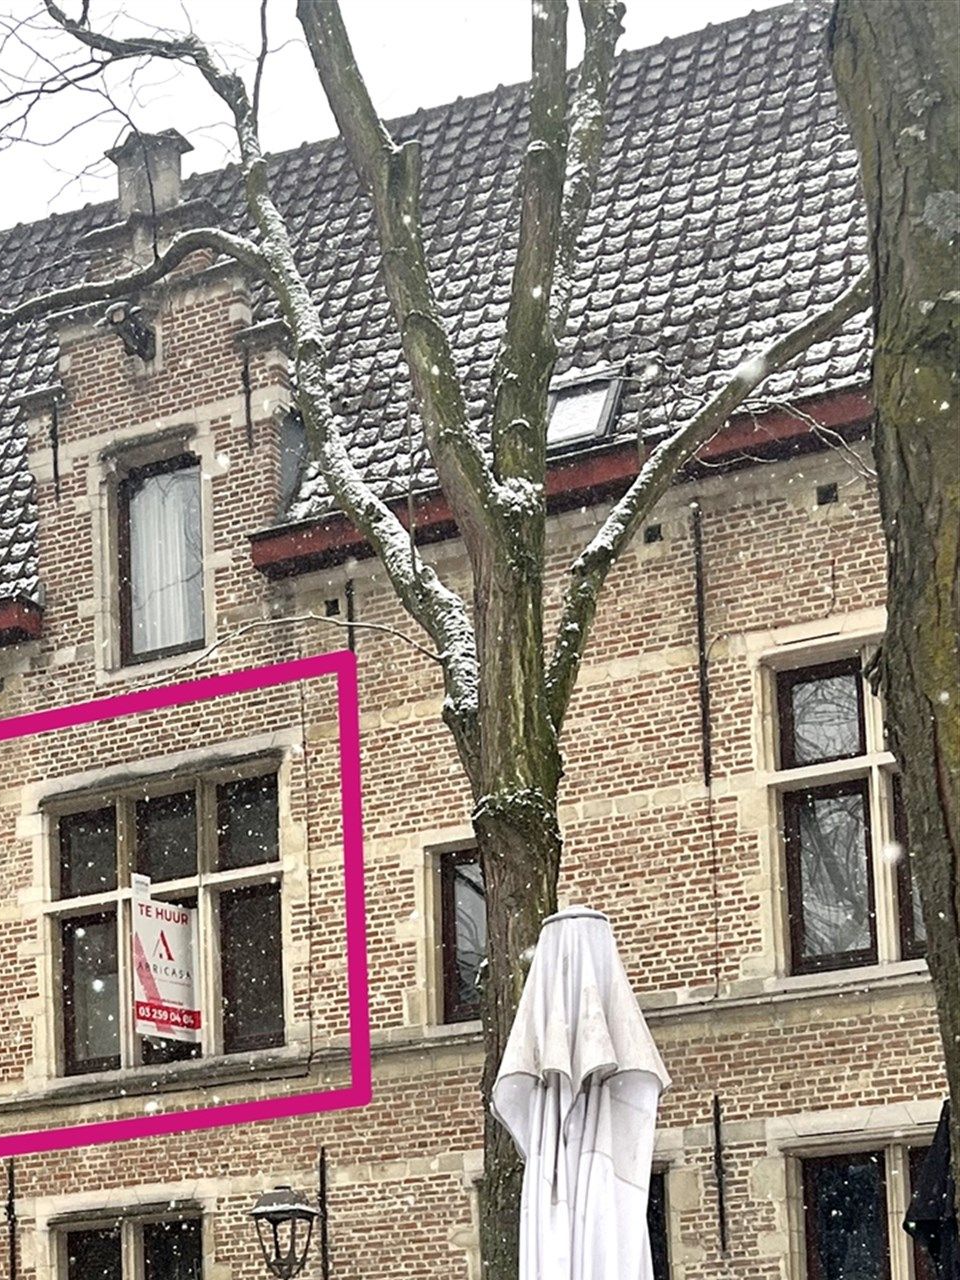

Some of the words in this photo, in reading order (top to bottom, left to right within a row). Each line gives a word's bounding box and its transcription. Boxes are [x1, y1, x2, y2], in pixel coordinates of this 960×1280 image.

[138, 903, 152, 918] TE
[155, 907, 189, 925] HUUR
[139, 1006, 151, 1018] 03
[152, 1008, 169, 1021] 259
